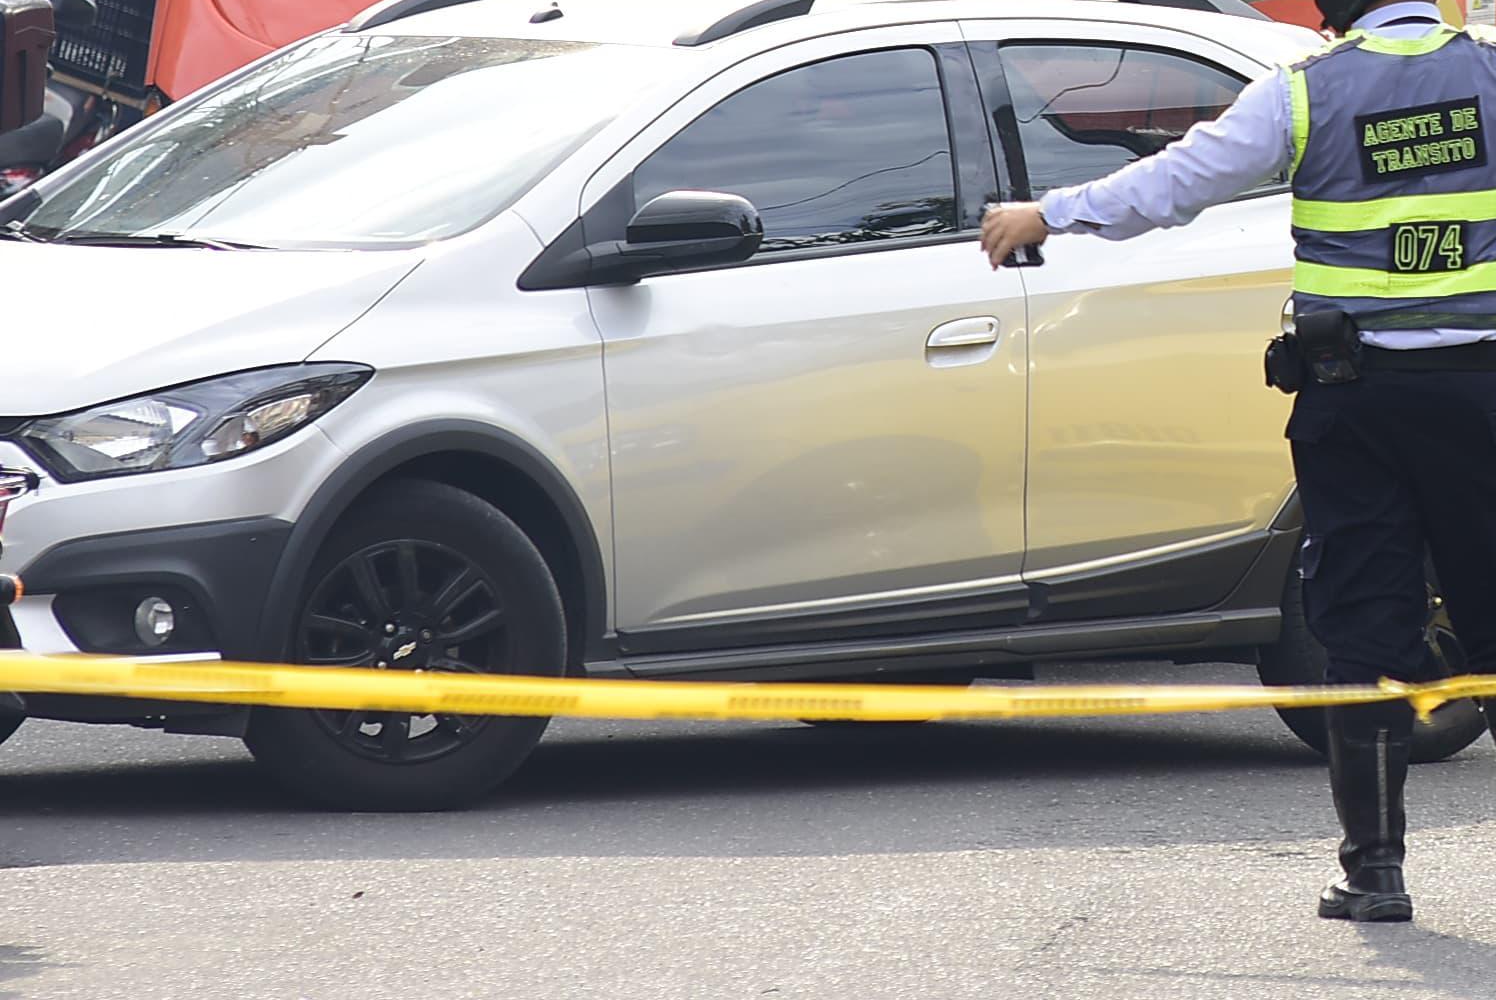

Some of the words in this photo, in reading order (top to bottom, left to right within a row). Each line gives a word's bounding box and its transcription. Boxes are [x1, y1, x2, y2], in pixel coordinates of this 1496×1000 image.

[1363, 113, 1444, 147] AGENTE
[1450, 107, 1479, 132] DE
[1372, 137, 1477, 174] TRANSITO
[1394, 224, 1464, 271] 074
